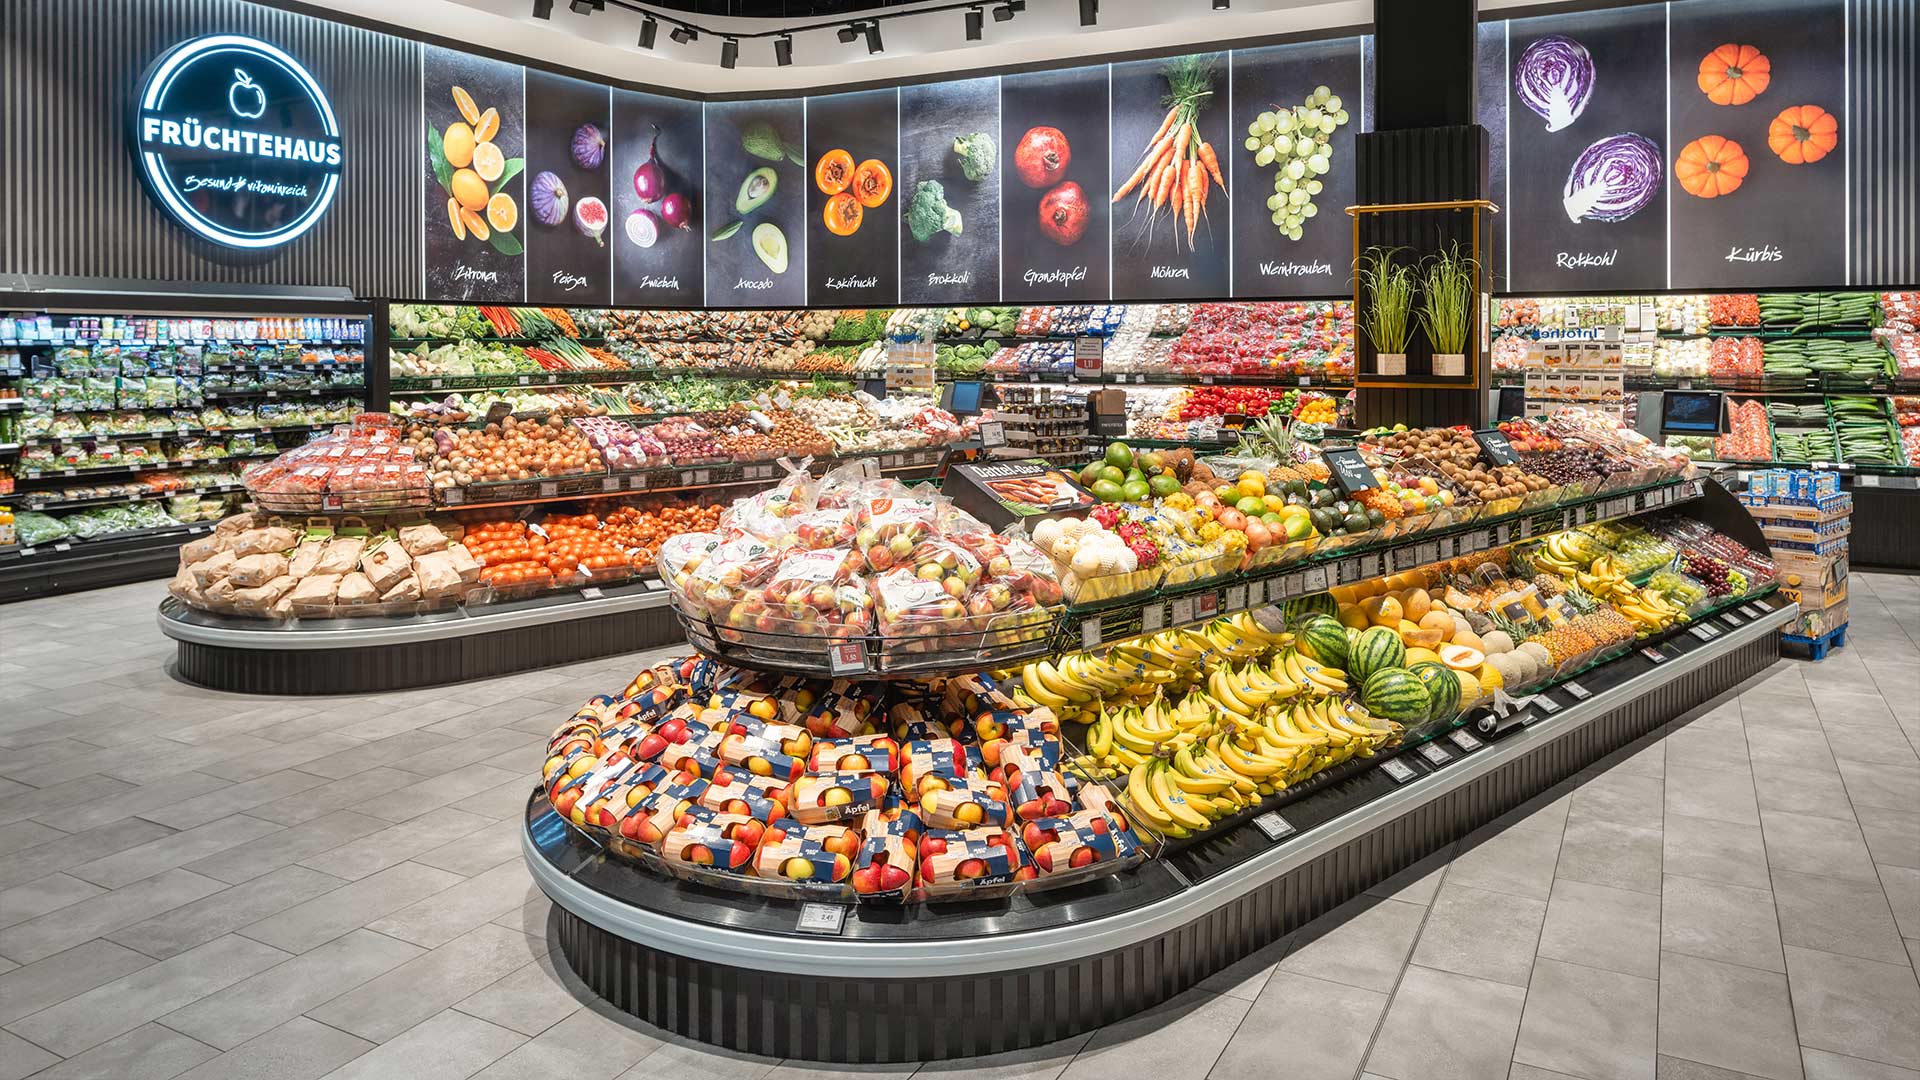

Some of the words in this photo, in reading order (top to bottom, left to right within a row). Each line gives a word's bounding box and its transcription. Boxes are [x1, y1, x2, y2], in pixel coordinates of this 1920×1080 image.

[144, 117, 341, 165] FRÜCHTEHAUS
[247, 180, 308, 197] vitaminreich
[1556, 249, 1618, 270] Rotkohl
[1725, 244, 1784, 262] Kürbis
[455, 265, 498, 283] Zitronen
[1151, 266, 1190, 280] Möhren
[1259, 259, 1333, 276] Weintrauben
[552, 270, 587, 291] Feigen
[640, 275, 679, 290] Zwiebeln
[733, 277, 774, 290] Avocado
[825, 274, 878, 290] Kakifrucht
[928, 271, 971, 286] Brokkoli
[1023, 266, 1087, 287] Granatapfel
[972, 463, 1044, 479] Dattel-Oase
[844, 803, 870, 815] Äpfel
[980, 876, 1006, 886] Äpfel
